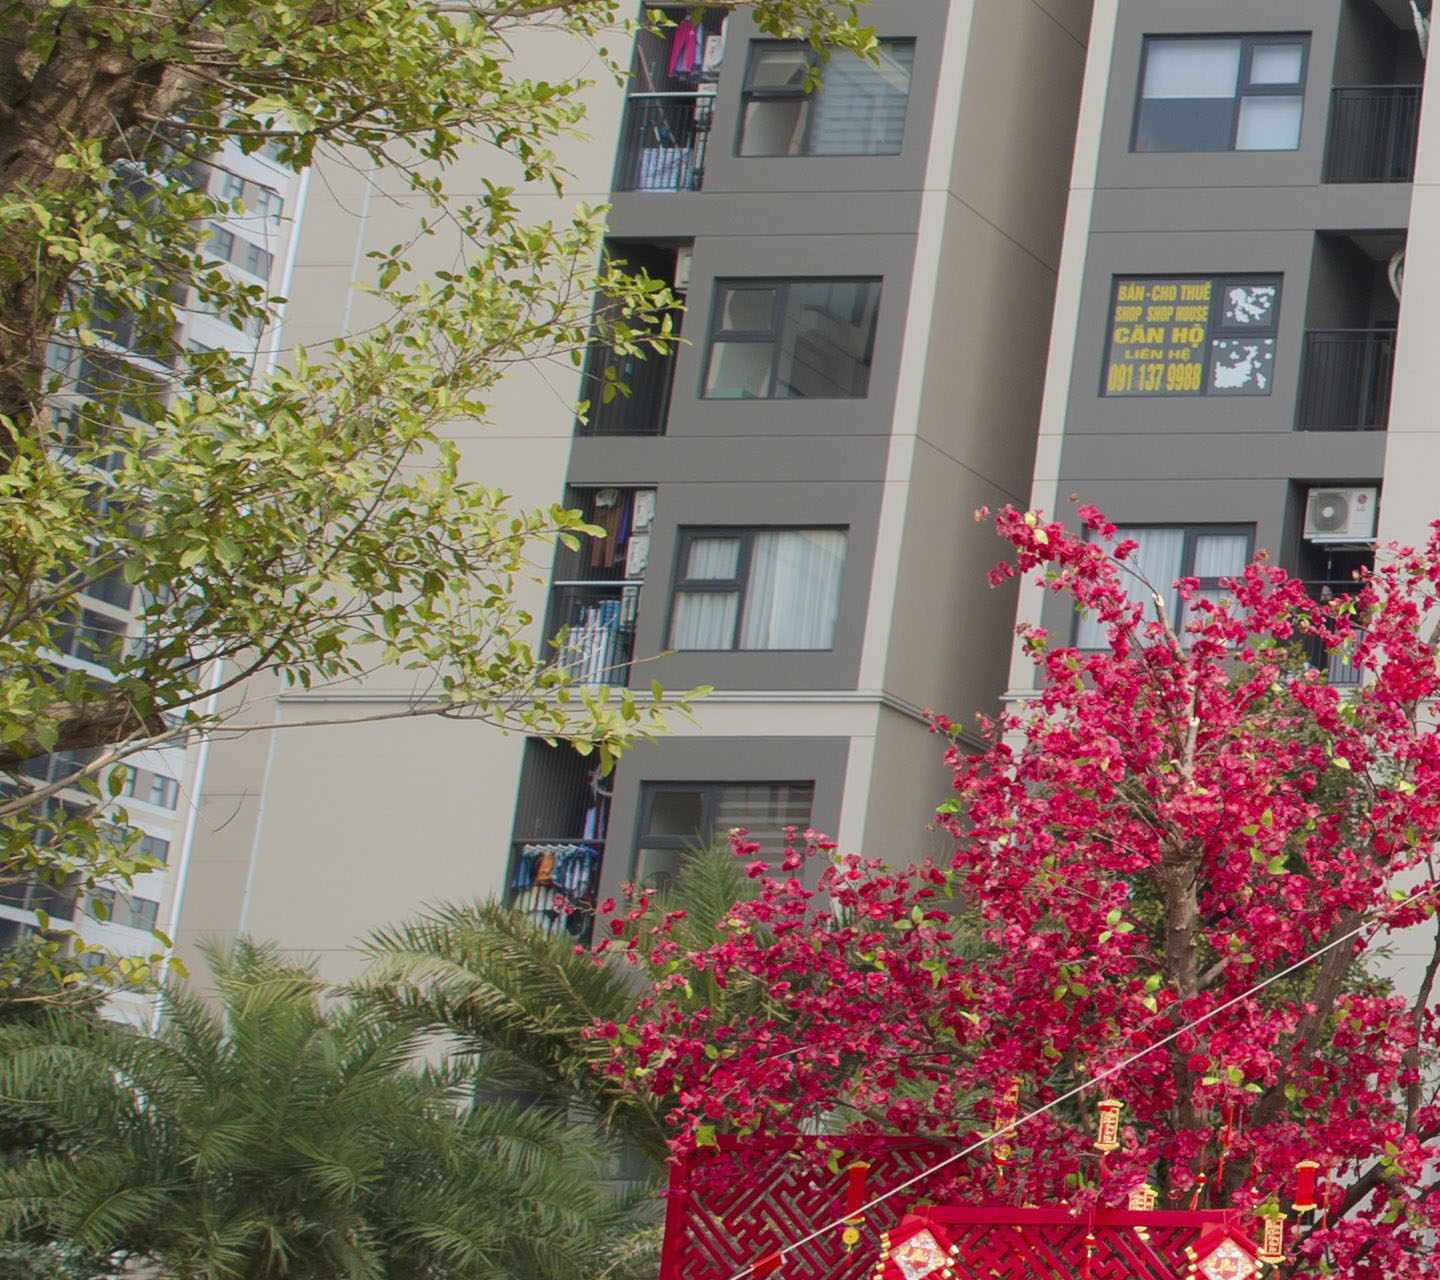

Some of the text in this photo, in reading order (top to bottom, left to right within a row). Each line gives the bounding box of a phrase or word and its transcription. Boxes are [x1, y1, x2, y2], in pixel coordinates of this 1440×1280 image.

[1115, 305, 1209, 322] SHOP SHOP HOUSE
[1113, 323, 1205, 348] CĂN HỘ
[1107, 362, 1203, 392] 091 137 9988
